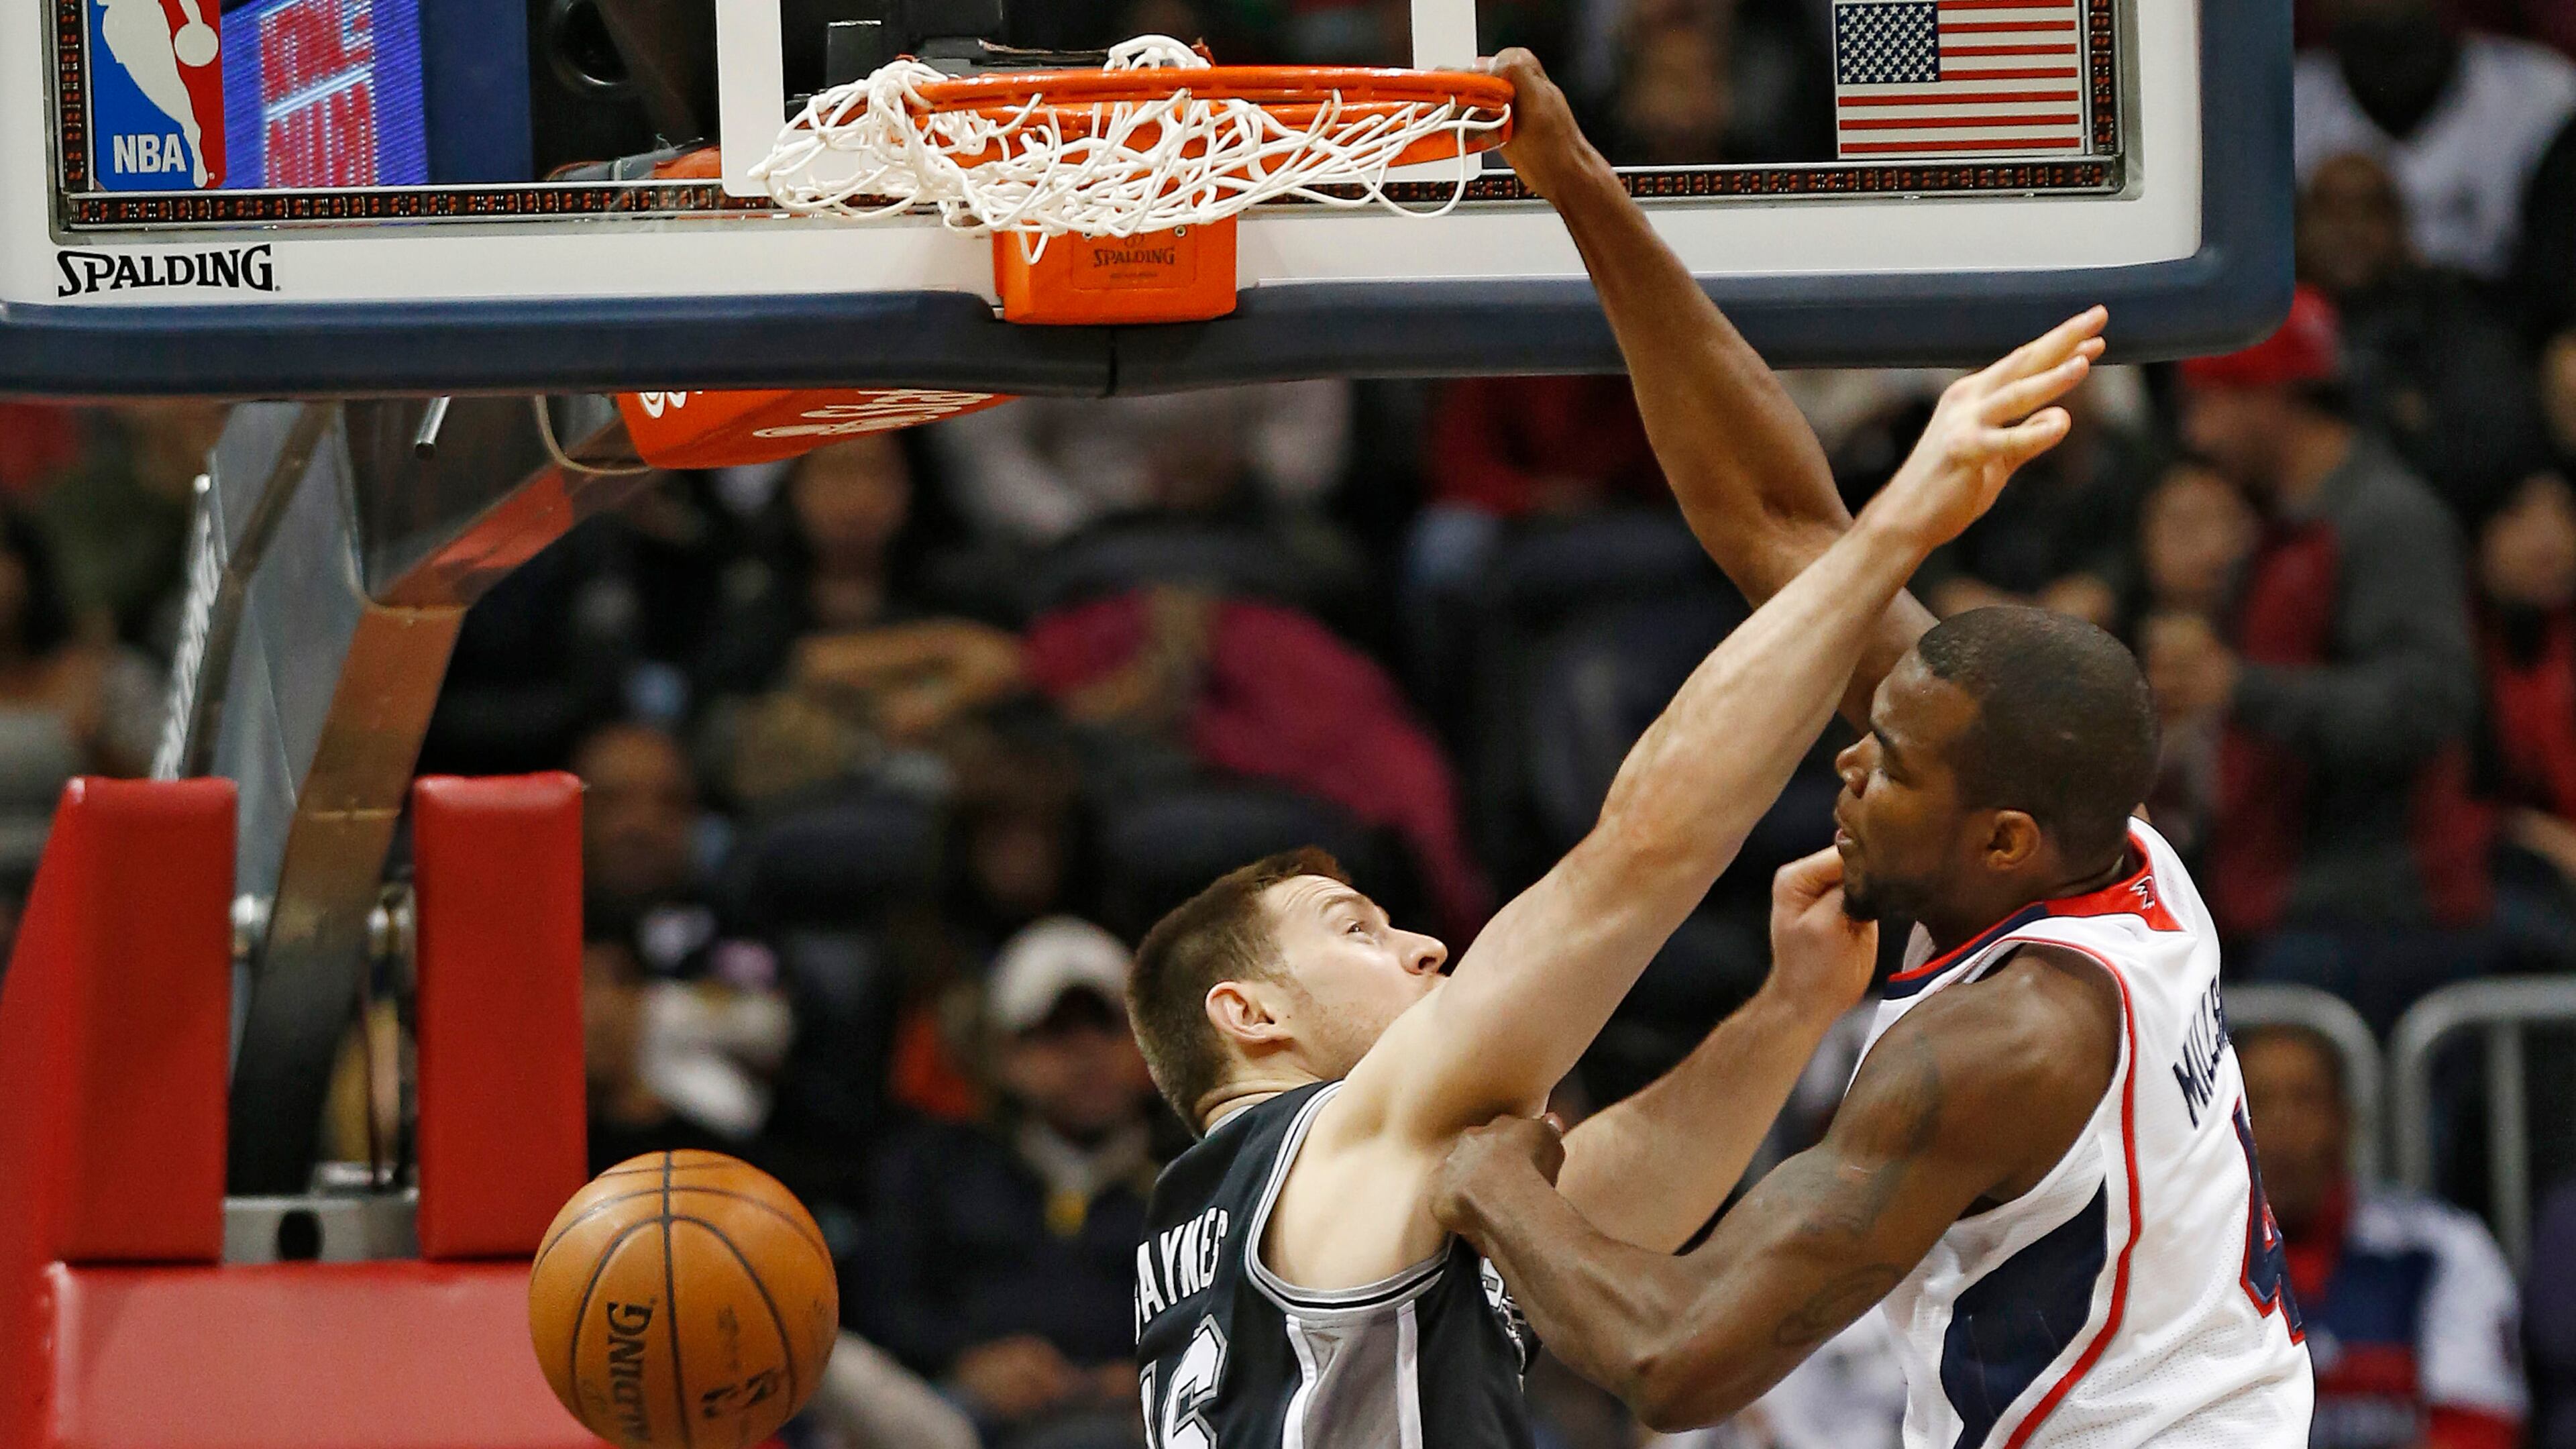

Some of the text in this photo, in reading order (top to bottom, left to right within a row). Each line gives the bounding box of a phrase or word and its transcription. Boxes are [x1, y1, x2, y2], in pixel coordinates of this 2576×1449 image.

[113, 133, 187, 174] NBA
[57, 244, 273, 297] SPALDING
[1093, 247, 1175, 268] SPALDING
[1135, 1206, 1229, 1344] AYNES
[606, 1301, 653, 1440] ALDING
